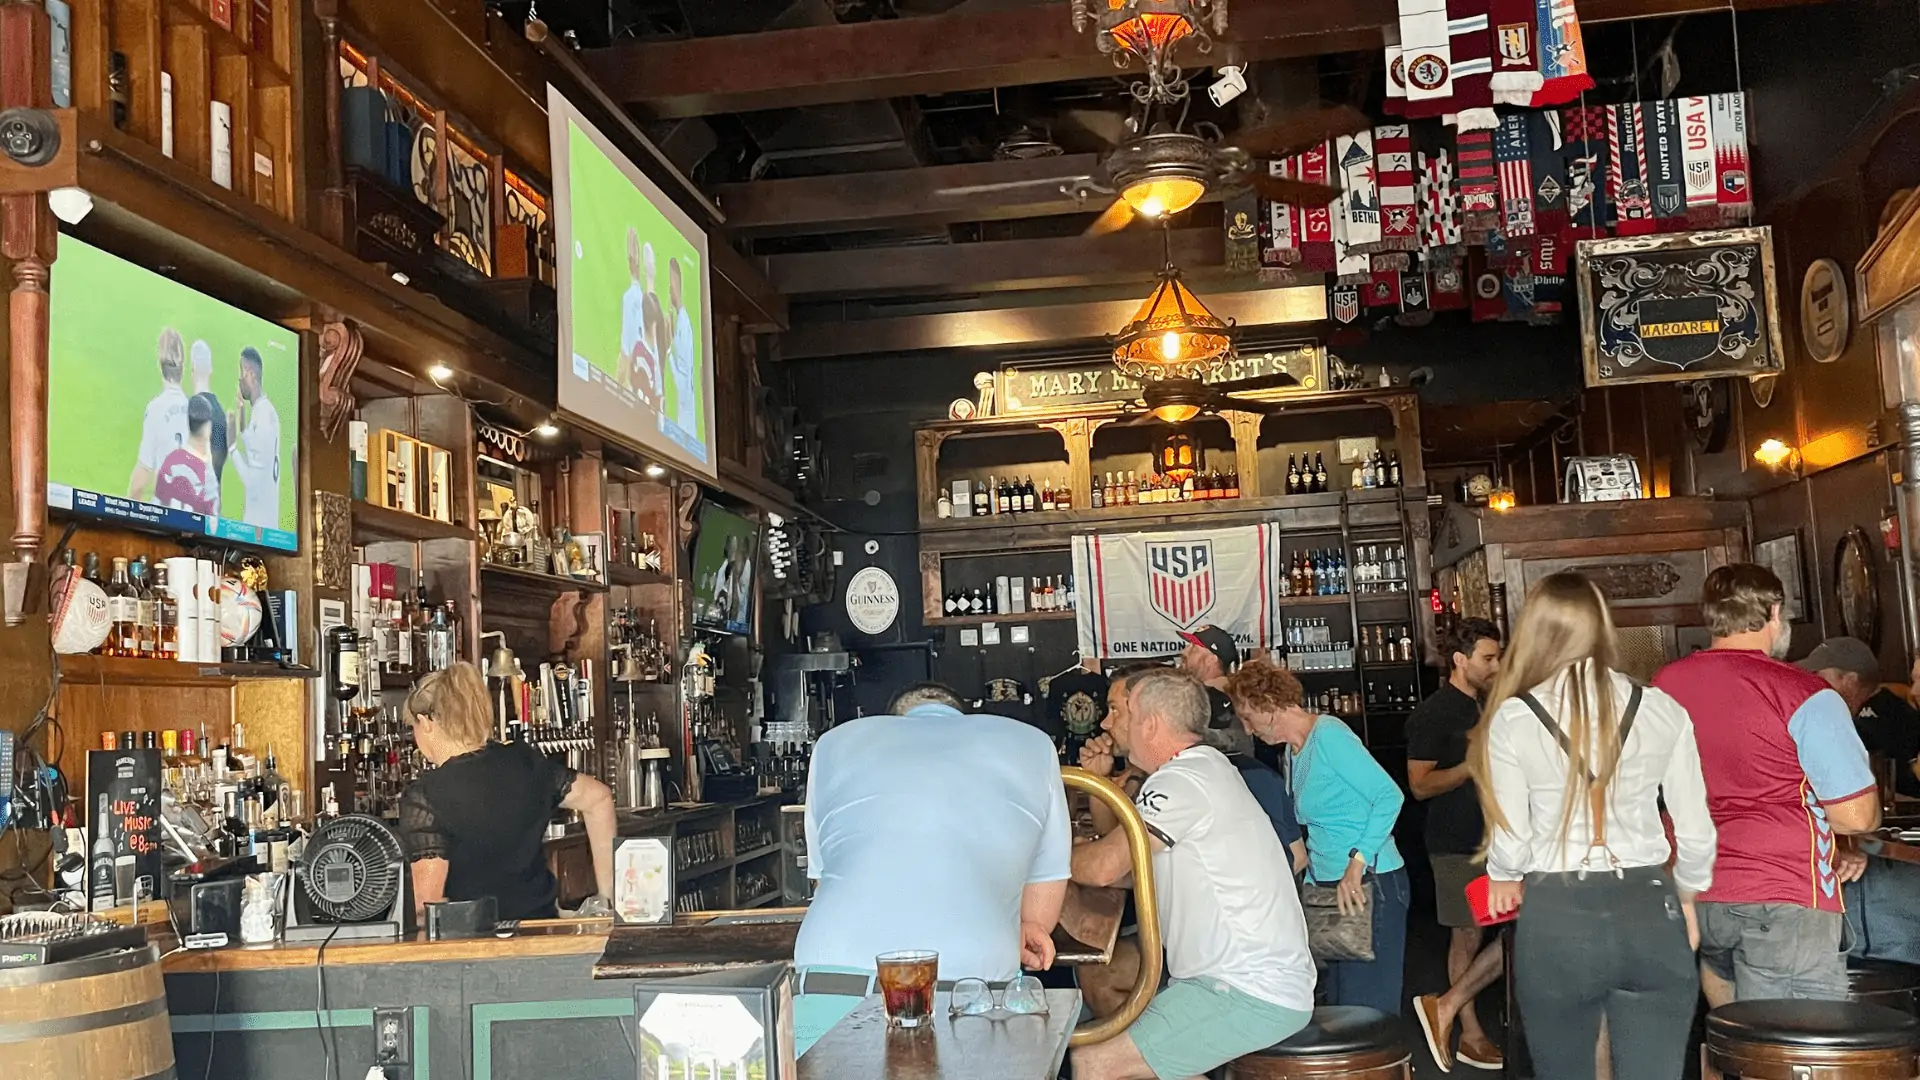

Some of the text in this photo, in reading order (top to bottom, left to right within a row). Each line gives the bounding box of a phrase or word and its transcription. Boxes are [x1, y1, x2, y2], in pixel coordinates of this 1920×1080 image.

[1622, 102, 1636, 153] American
[1686, 111, 1707, 151] USA
[1658, 136, 1671, 180] UNITED
[1688, 161, 1710, 174] USA
[1335, 292, 1356, 306] USA
[1030, 369, 1103, 398] MARY
[1151, 545, 1209, 578] USA
[89, 596, 106, 609] USA
[850, 594, 896, 605] GUINNESS
[1113, 641, 1143, 653] ONE
[113, 799, 137, 815] LIVE
